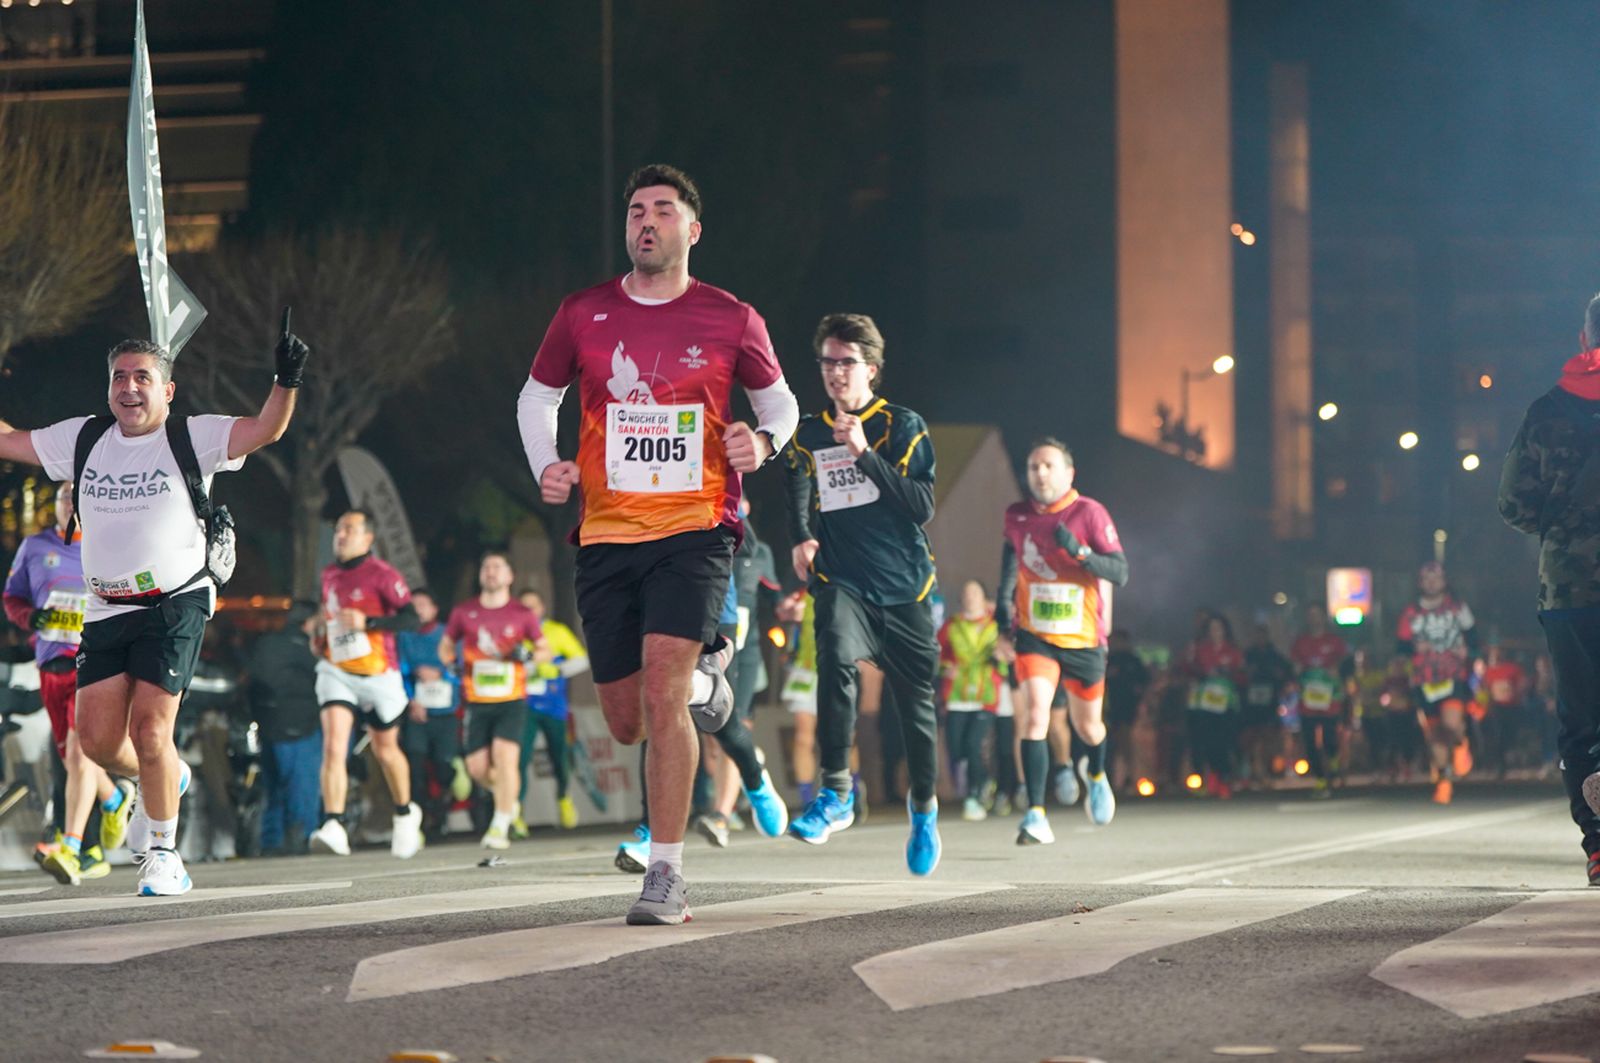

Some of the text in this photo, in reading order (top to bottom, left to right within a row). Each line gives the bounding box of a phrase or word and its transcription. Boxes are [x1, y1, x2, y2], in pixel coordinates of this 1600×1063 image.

[628, 415, 670, 424] NOCHE DE
[618, 425, 636, 434] SAN
[637, 424, 669, 435] ANTÓN
[624, 436, 686, 462] 2005
[84, 467, 169, 485] DACIA
[827, 467, 866, 488] 3335
[82, 481, 171, 500] JAPEMASA
[124, 504, 150, 513] OFICIAL
